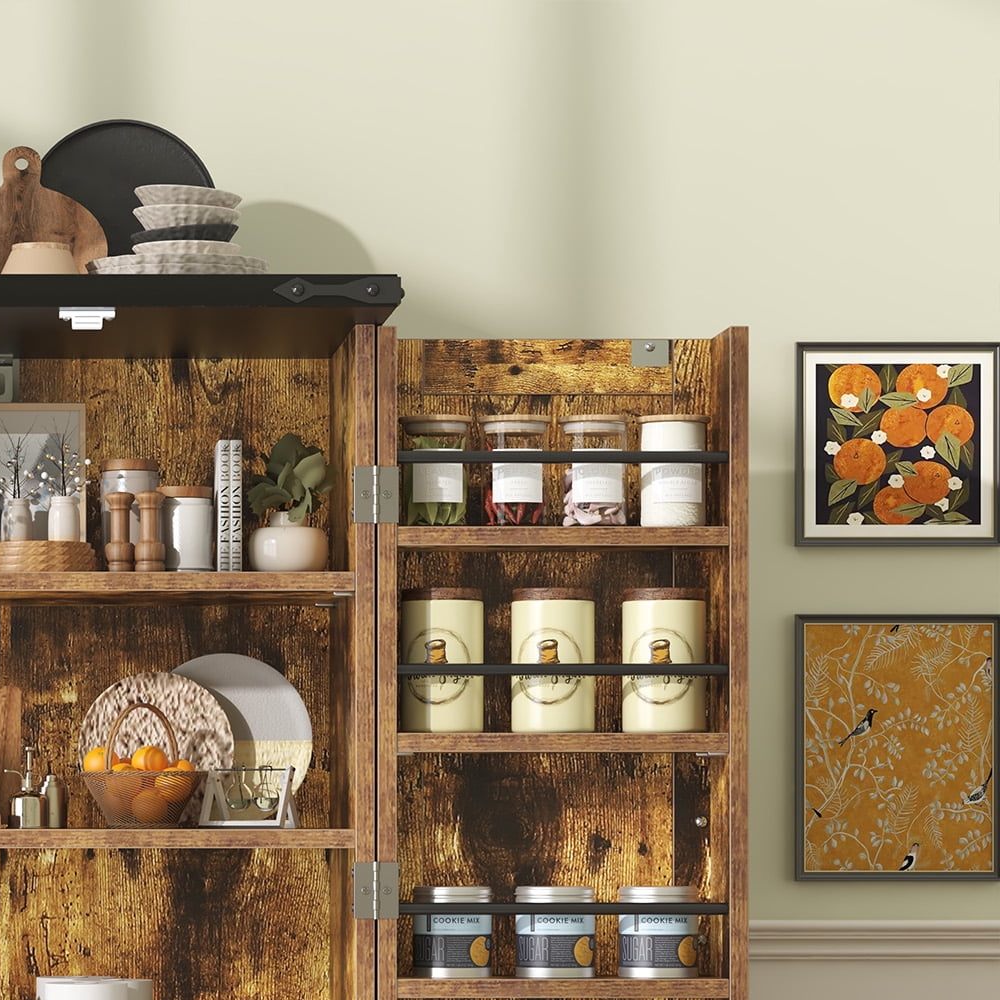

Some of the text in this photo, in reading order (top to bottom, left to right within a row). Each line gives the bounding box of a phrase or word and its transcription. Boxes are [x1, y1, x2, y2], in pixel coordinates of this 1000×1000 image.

[220, 444, 229, 571] THE FASHION BOOK
[231, 444, 241, 571] THE FASHION BOOK
[519, 936, 549, 961] SUGAR
[622, 936, 653, 961] SUGAR
